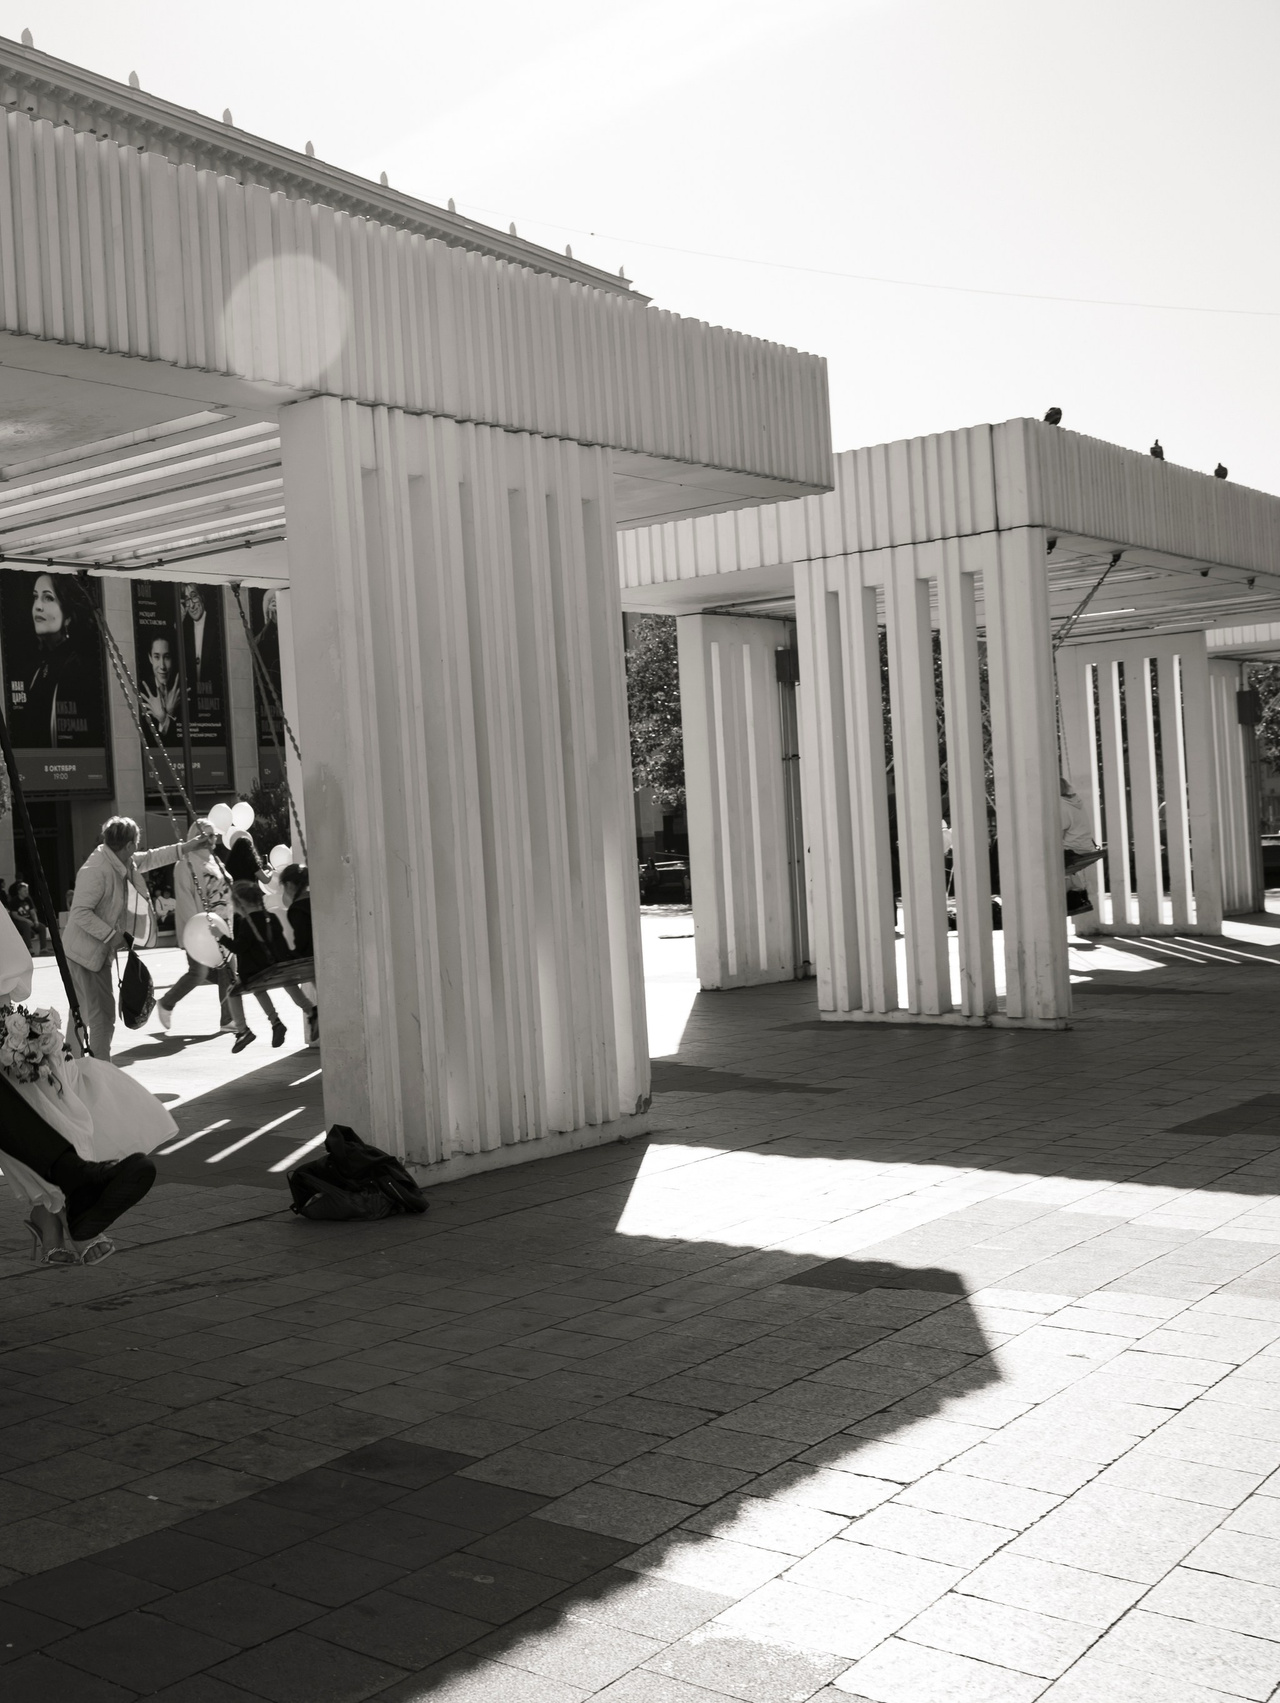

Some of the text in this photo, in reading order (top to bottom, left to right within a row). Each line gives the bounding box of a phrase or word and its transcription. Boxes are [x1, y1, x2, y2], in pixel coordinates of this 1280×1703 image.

[10, 680, 25, 691] ИВАН
[197, 697, 220, 711] БАШМЕТ
[57, 718, 89, 732] ГЕРЗМАВА
[44, 764, 77, 772] 8 ОКТЯБРЯ
[53, 772, 69, 780] 19:00
